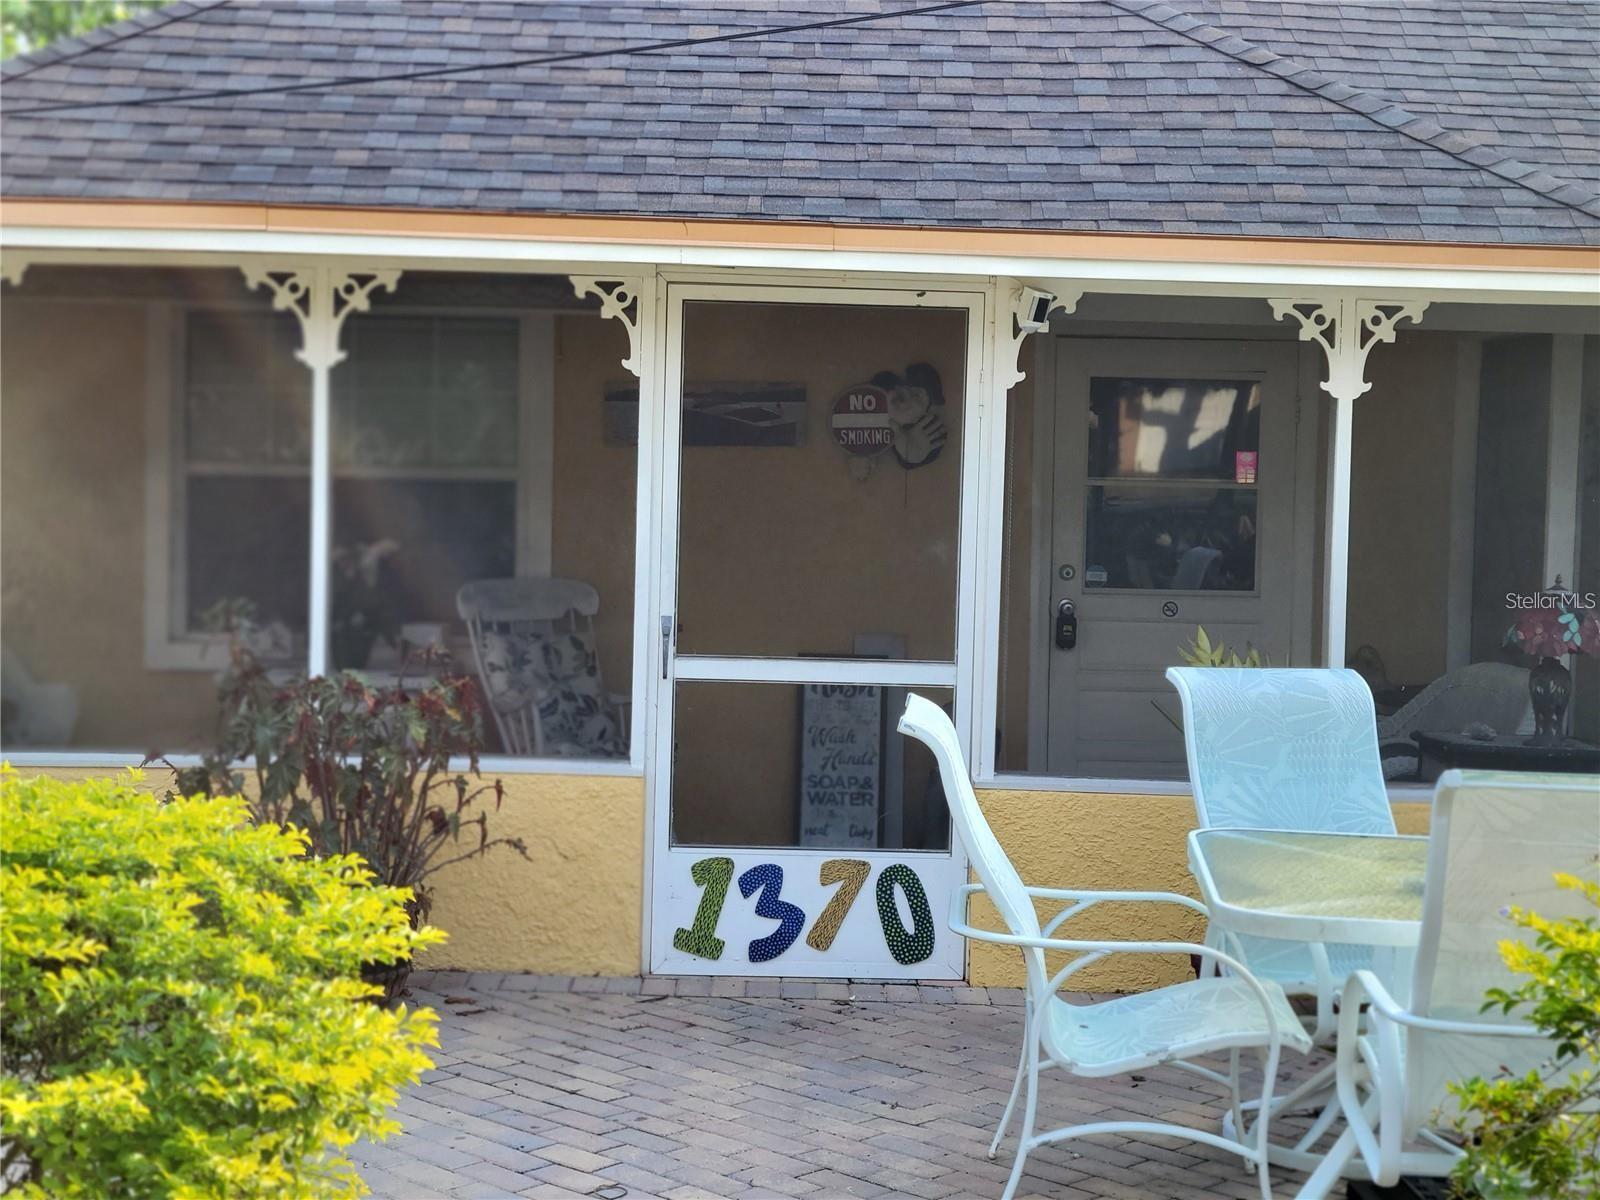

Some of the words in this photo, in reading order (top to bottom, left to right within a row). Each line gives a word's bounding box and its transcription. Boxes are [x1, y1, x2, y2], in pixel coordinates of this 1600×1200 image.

[848, 394, 877, 411] NO
[840, 429, 891, 445] SMOKING
[807, 774, 859, 790] SOAP
[807, 791, 875, 806] WATER
[673, 857, 935, 965] 1370
